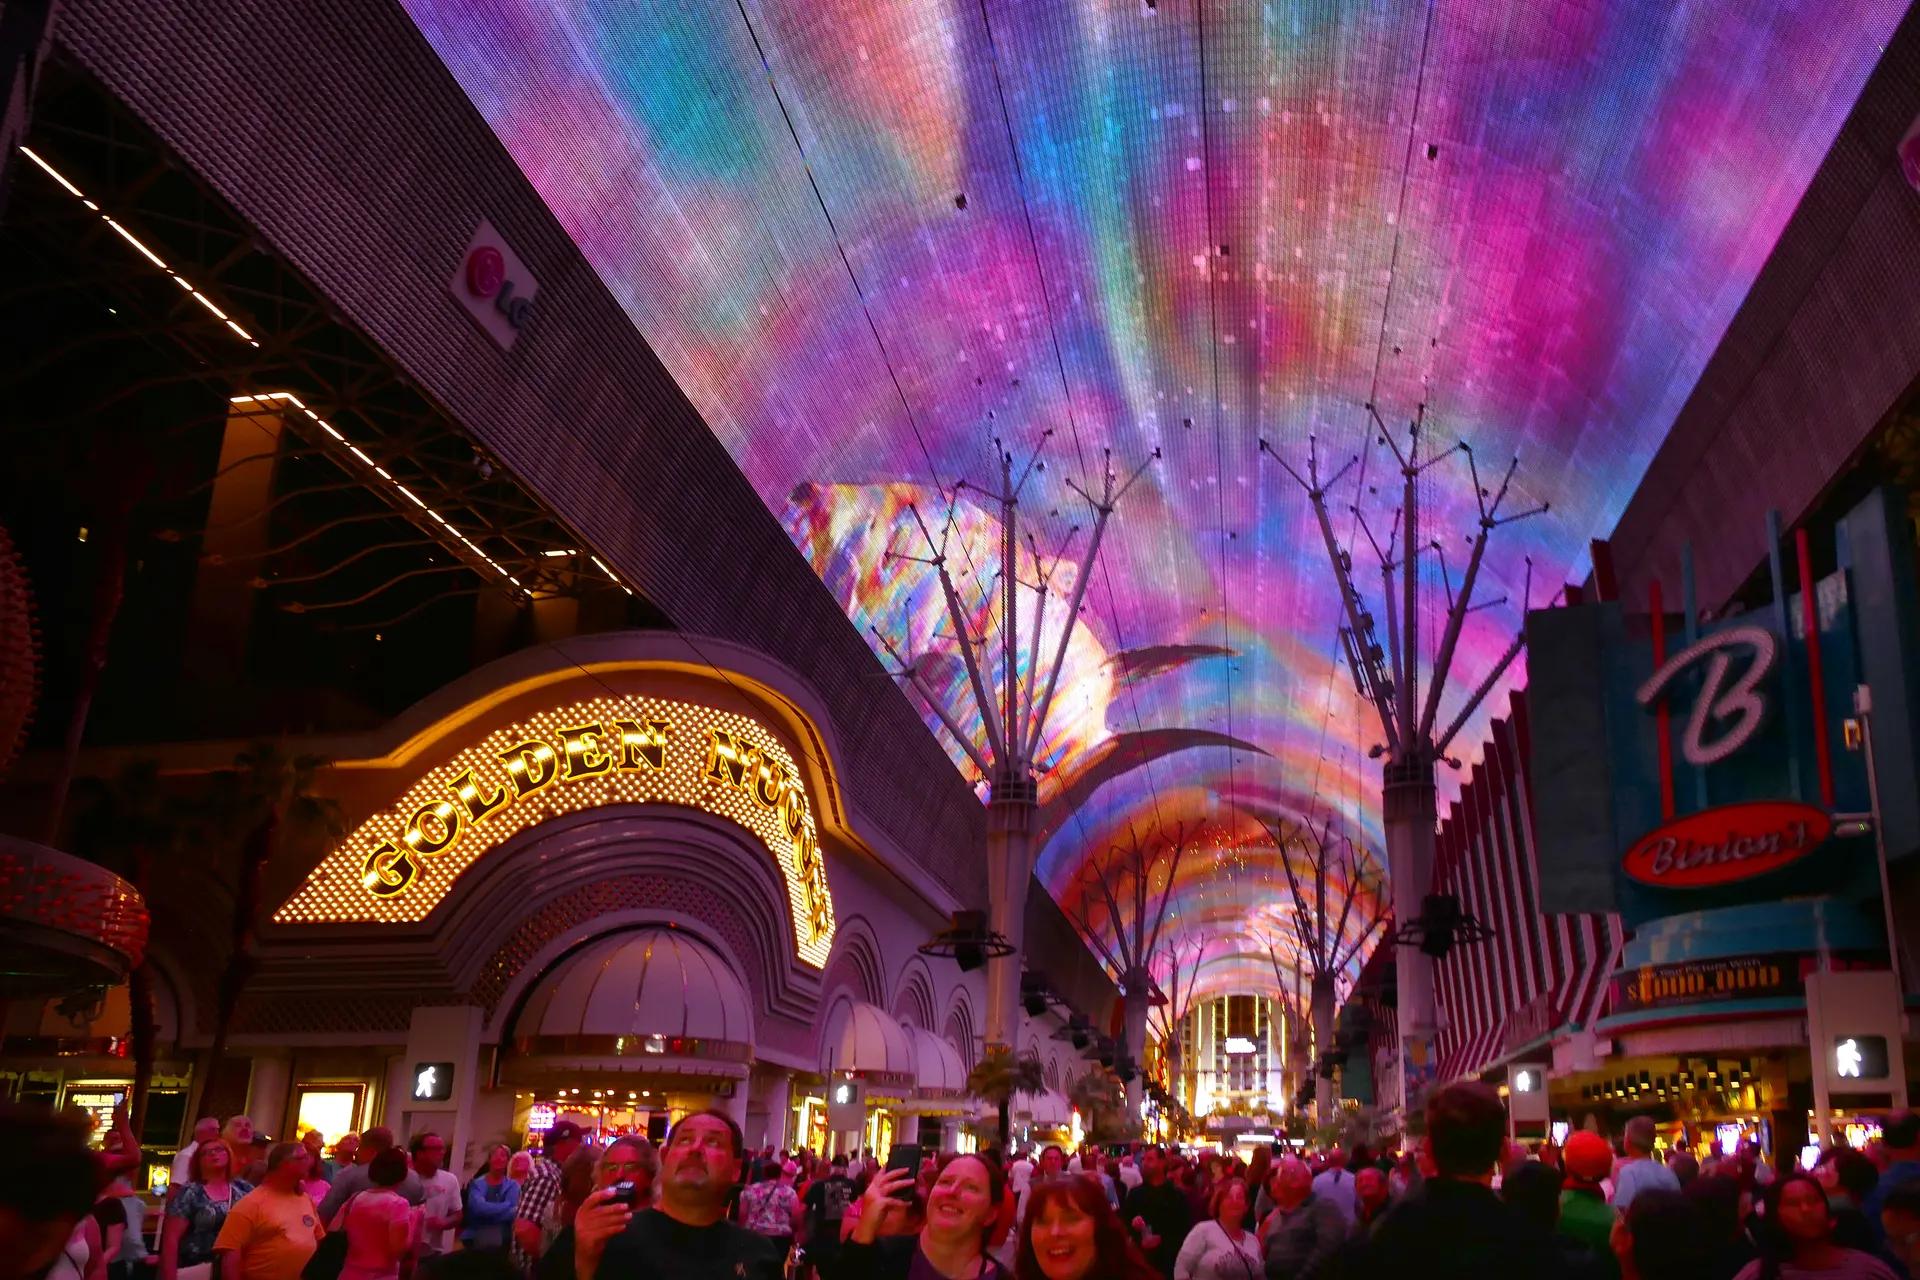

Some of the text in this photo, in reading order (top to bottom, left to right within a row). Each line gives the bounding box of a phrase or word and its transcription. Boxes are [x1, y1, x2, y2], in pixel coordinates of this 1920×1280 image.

[1635, 626, 1775, 767] B
[362, 718, 829, 945] GOLDEN NUGGET
